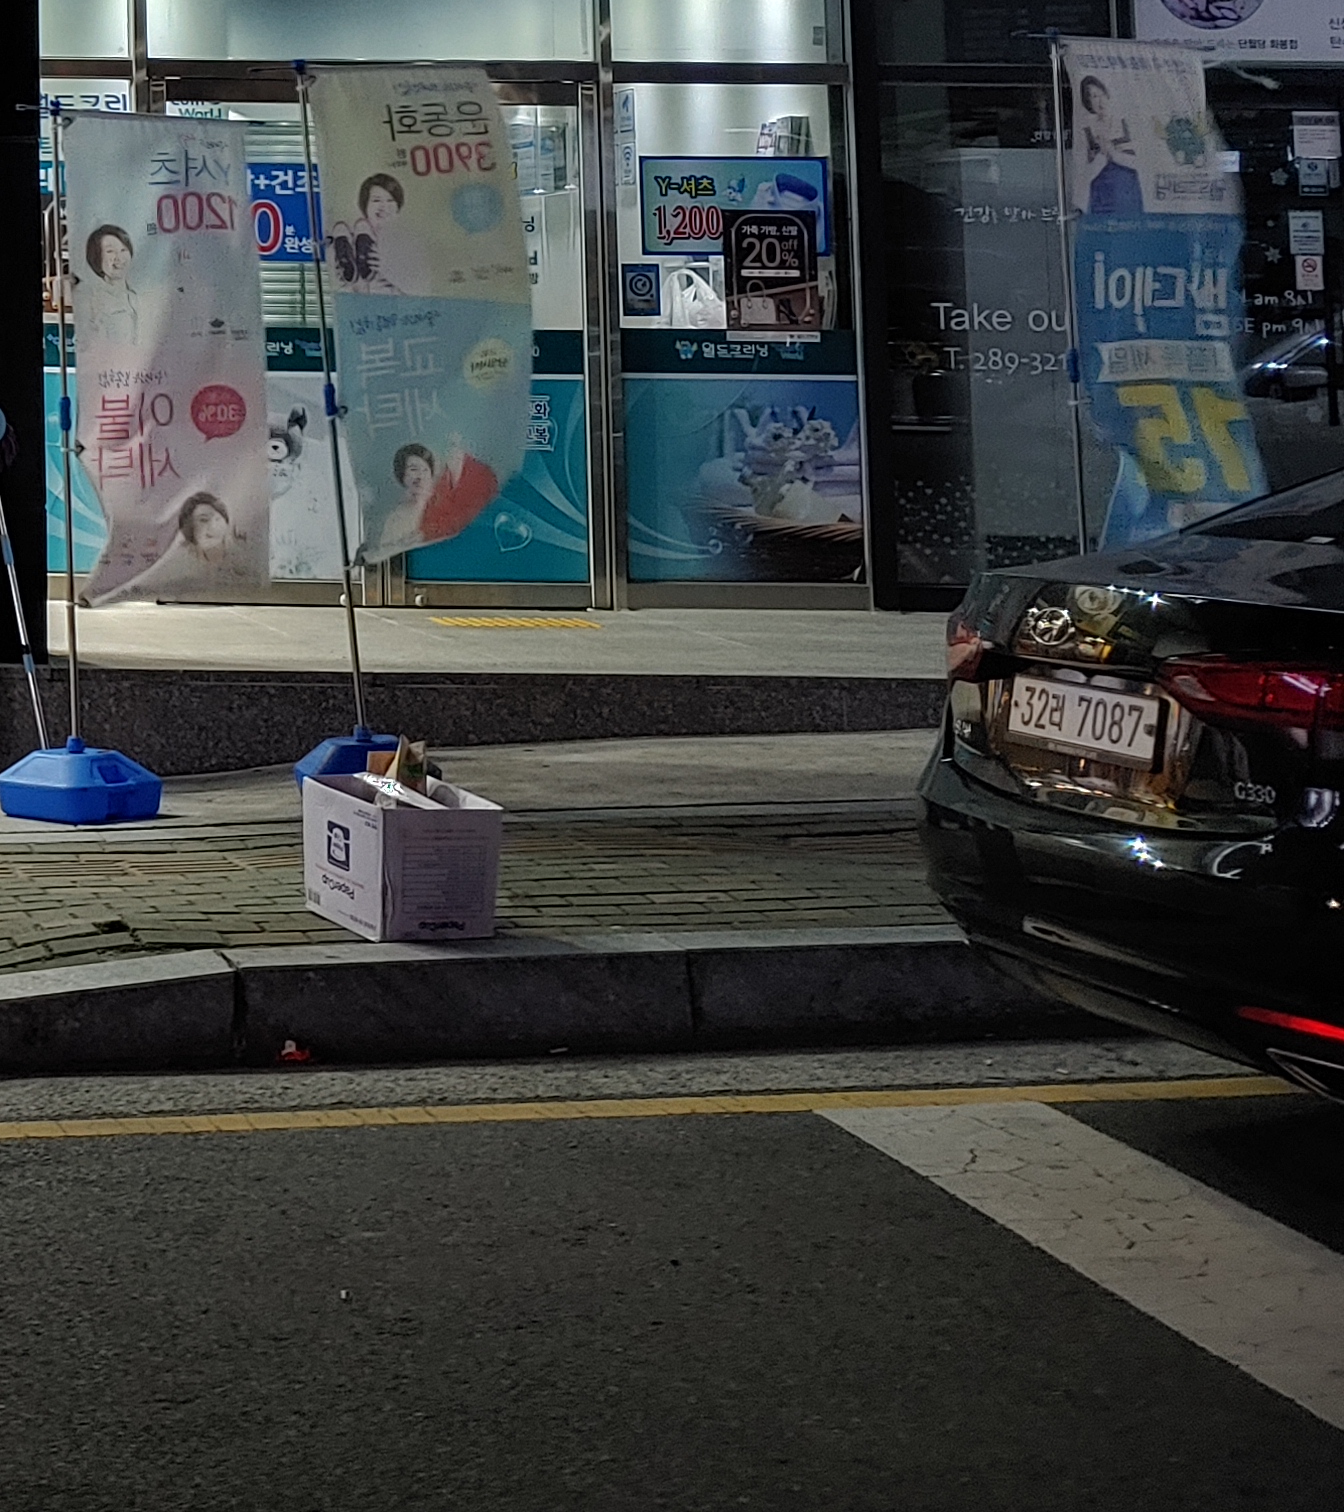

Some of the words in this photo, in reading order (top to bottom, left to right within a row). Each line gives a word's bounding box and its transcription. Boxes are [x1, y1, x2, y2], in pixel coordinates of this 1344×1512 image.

[930, 302, 1013, 331] Take
[1028, 307, 1070, 332] ou
[1076, 694, 1145, 749] 7087
